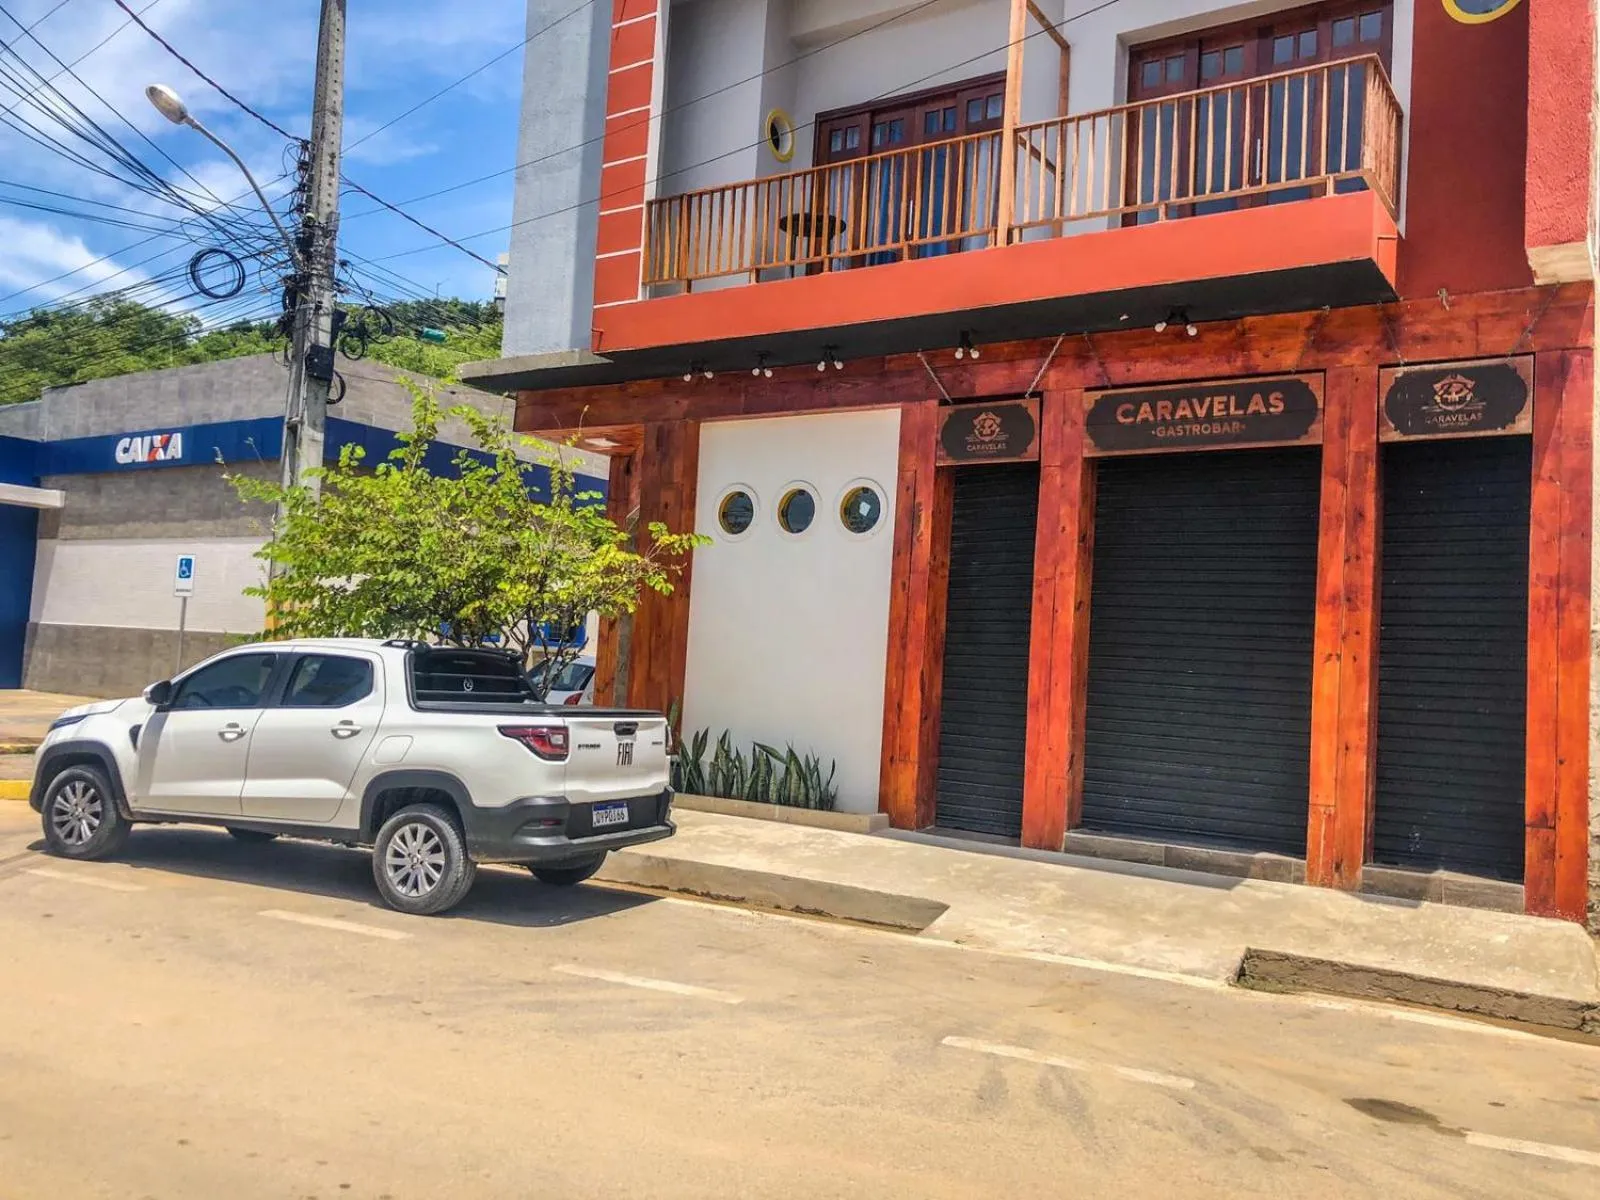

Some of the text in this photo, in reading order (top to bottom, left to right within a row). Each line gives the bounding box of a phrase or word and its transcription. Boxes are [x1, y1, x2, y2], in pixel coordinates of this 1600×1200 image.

[1115, 391, 1285, 424] CARAVELAS
[115, 432, 183, 464] CAIXA
[616, 742, 634, 766] FIAT
